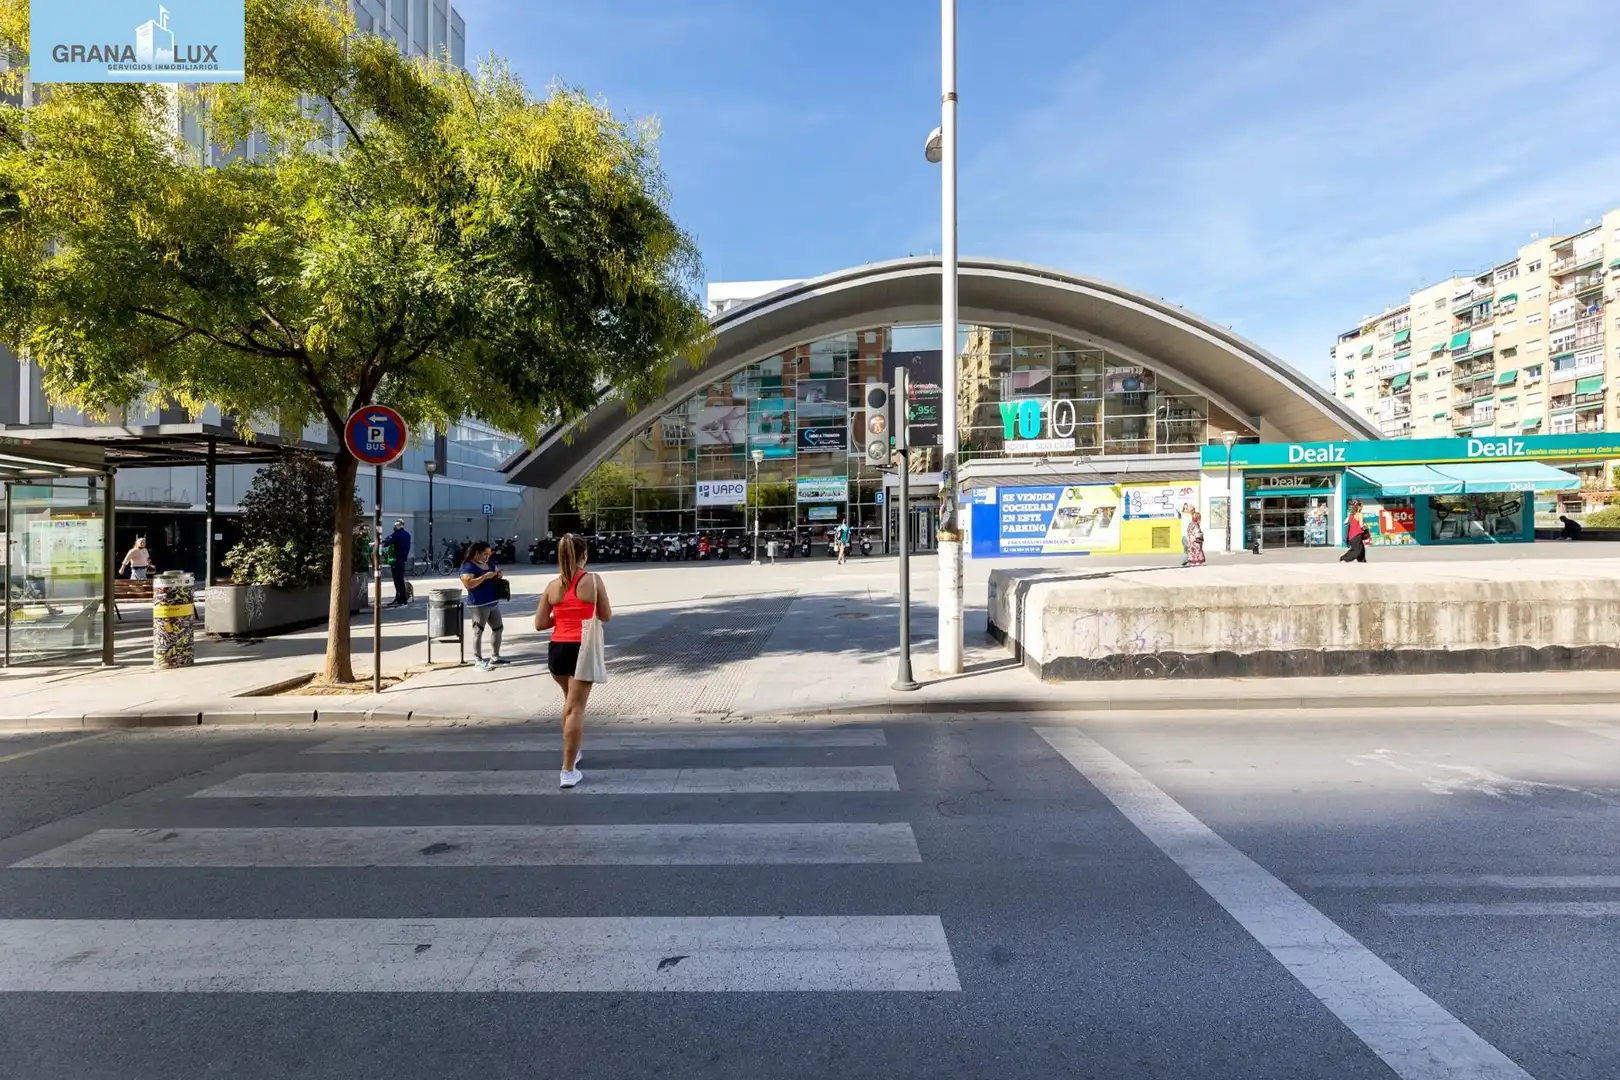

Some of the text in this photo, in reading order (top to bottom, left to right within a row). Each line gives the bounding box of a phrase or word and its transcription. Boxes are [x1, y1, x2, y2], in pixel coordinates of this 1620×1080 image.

[371, 428, 381, 440] P
[366, 442, 386, 451] BUS
[1467, 438, 1525, 457] Dealz
[1288, 443, 1345, 463] Dealz
[1270, 476, 1305, 488] Dealz
[1510, 482, 1536, 491] Dealz
[712, 484, 744, 495] UAPO
[1409, 485, 1435, 494] Dealz
[1002, 493, 1056, 502] SE VENDEN
[1002, 503, 1054, 512] COCHERAS
[1002, 514, 1042, 522] EN ESTE
[1002, 524, 1046, 533] PARKING
